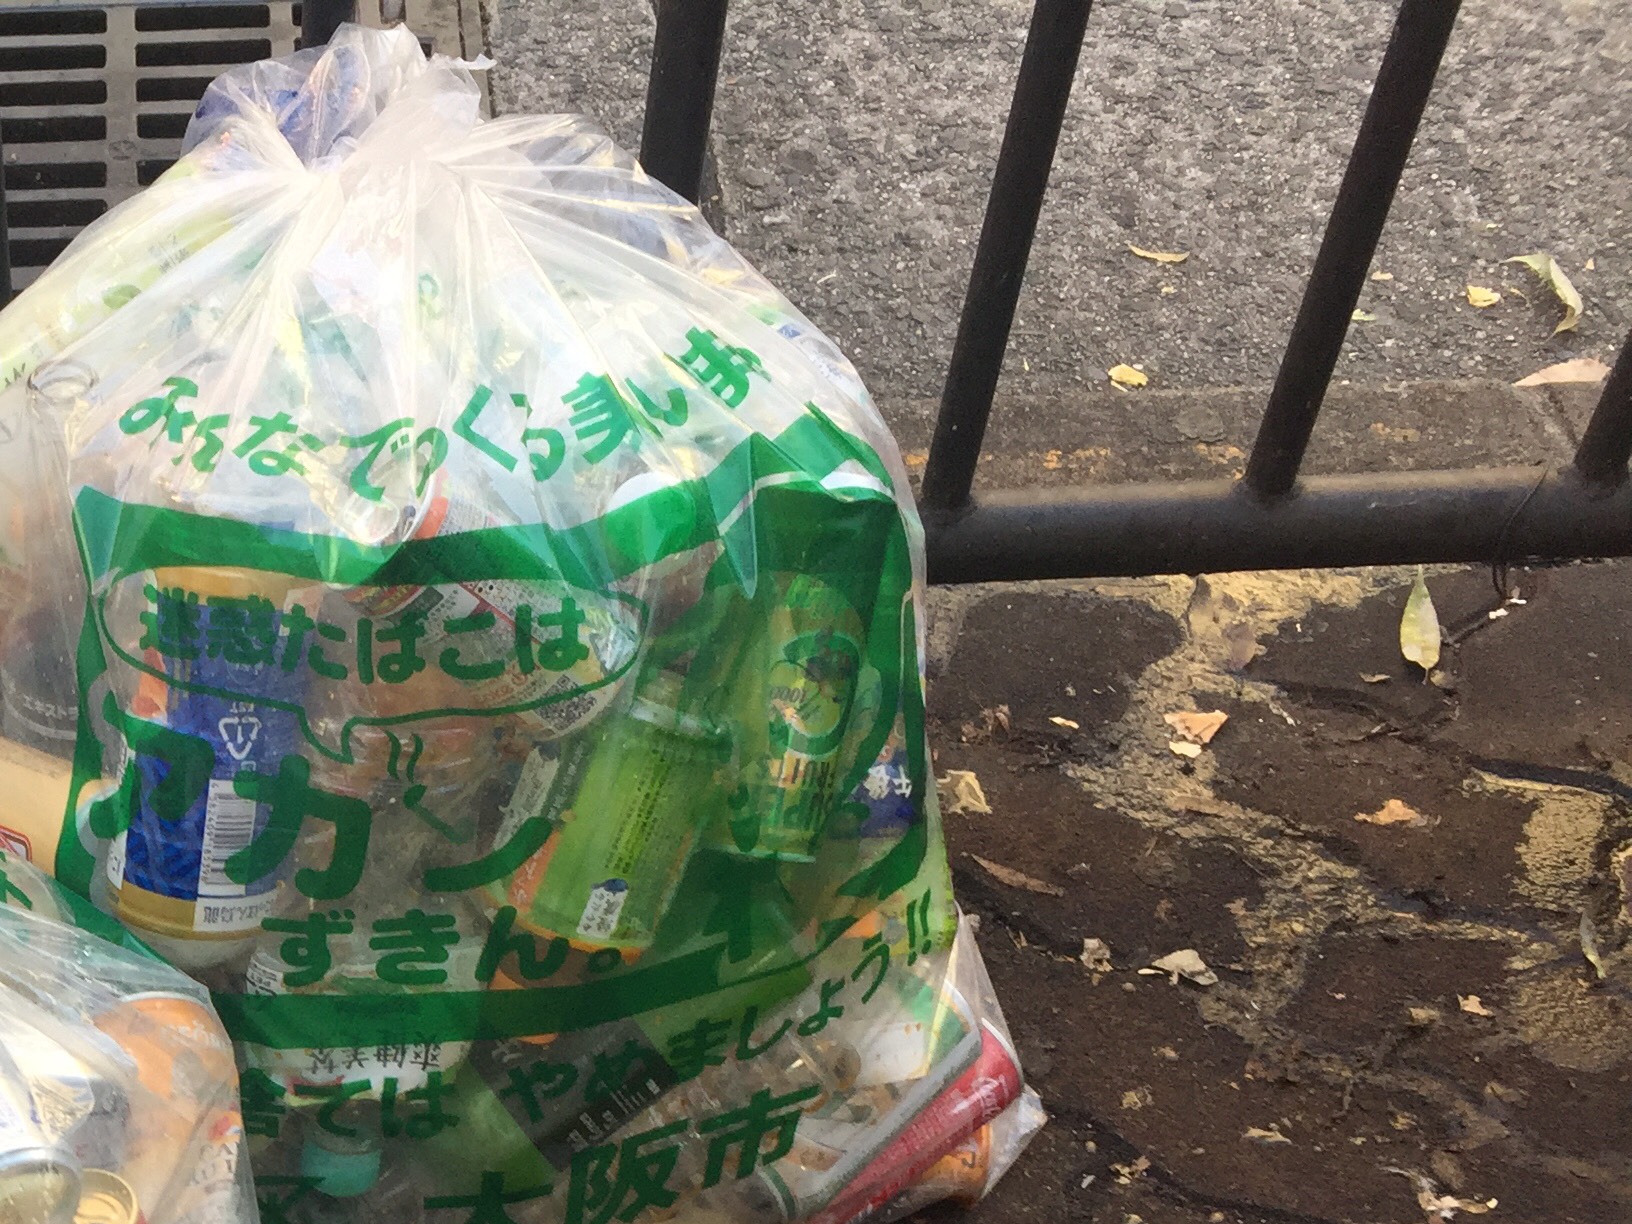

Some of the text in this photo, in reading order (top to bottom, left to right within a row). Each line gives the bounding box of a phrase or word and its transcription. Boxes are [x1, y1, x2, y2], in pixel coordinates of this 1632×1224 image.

[140, 584, 590, 685] 迷惑たばこは
[260, 908, 624, 988] ずきん。
